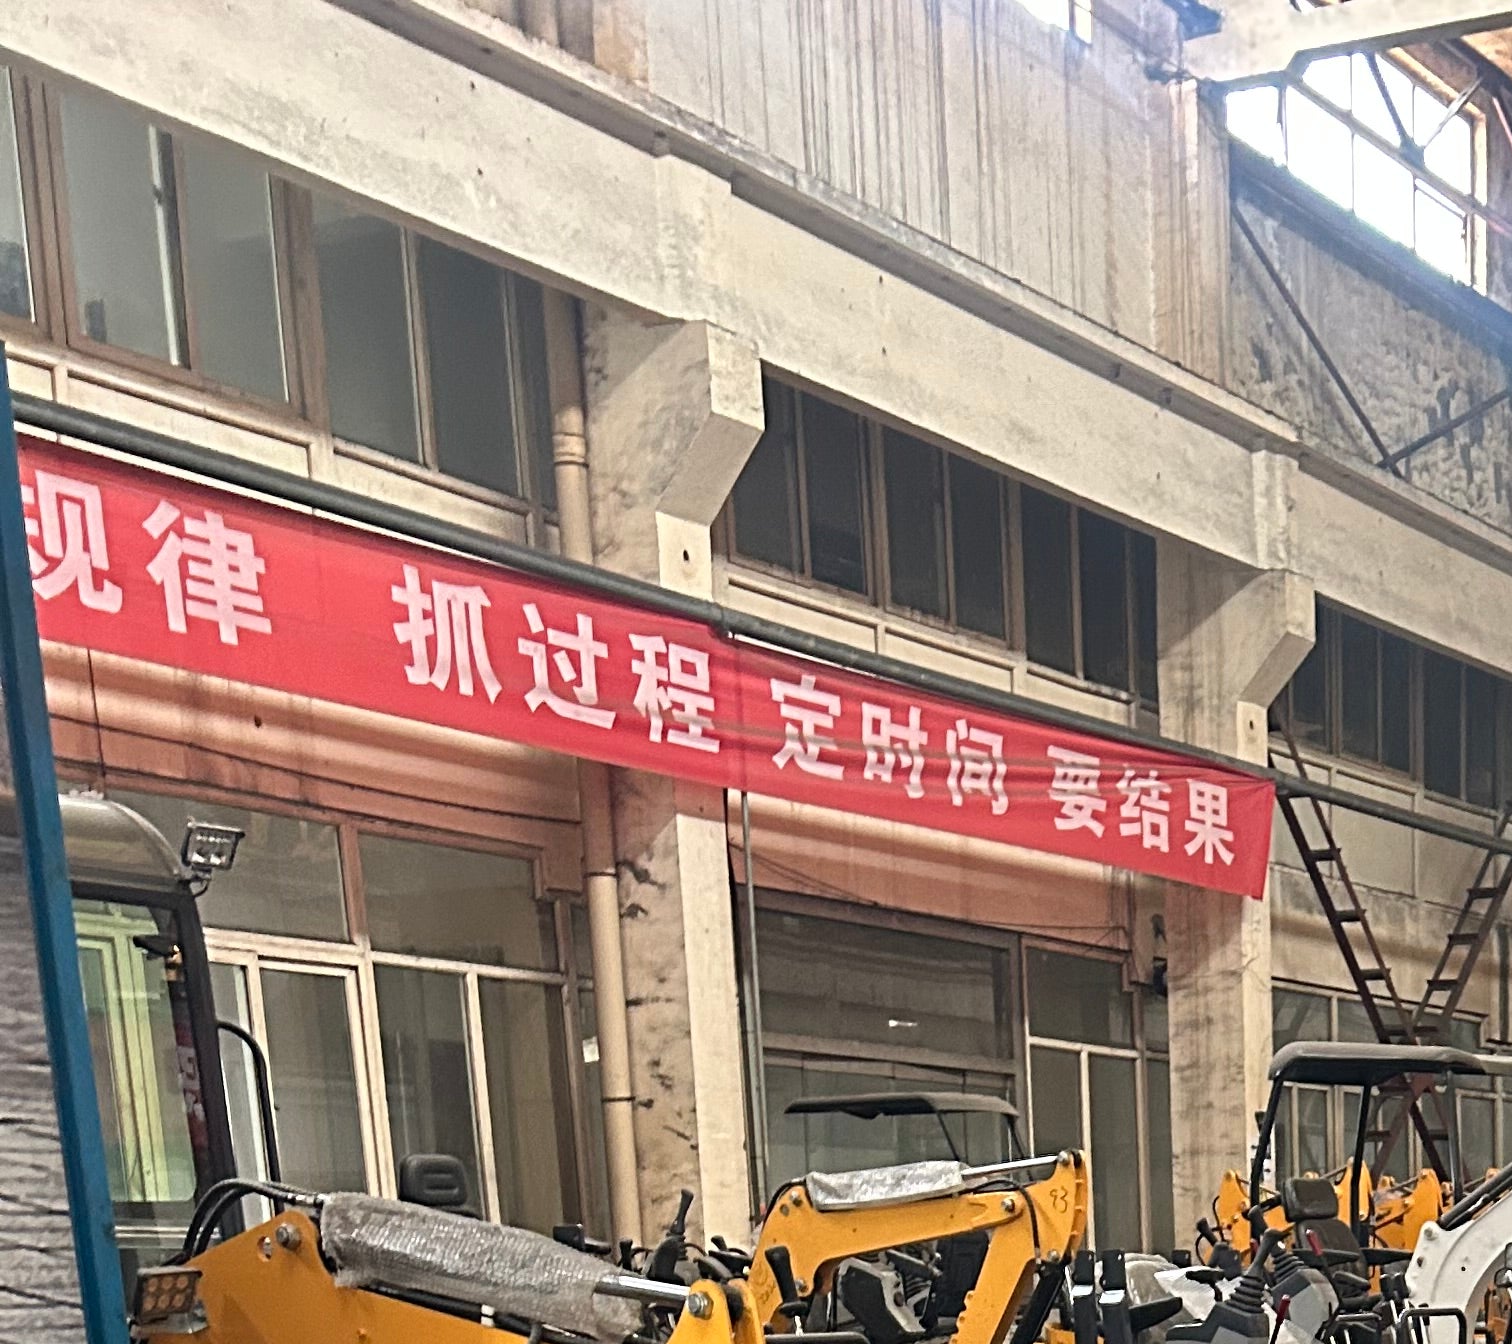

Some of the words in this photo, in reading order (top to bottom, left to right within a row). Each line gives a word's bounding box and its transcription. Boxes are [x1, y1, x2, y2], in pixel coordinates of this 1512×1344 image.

[21, 469, 272, 646] 规律
[391, 563, 720, 753] 抓过程
[770, 674, 1009, 815] 定时间
[1047, 744, 1235, 866] 要结果
